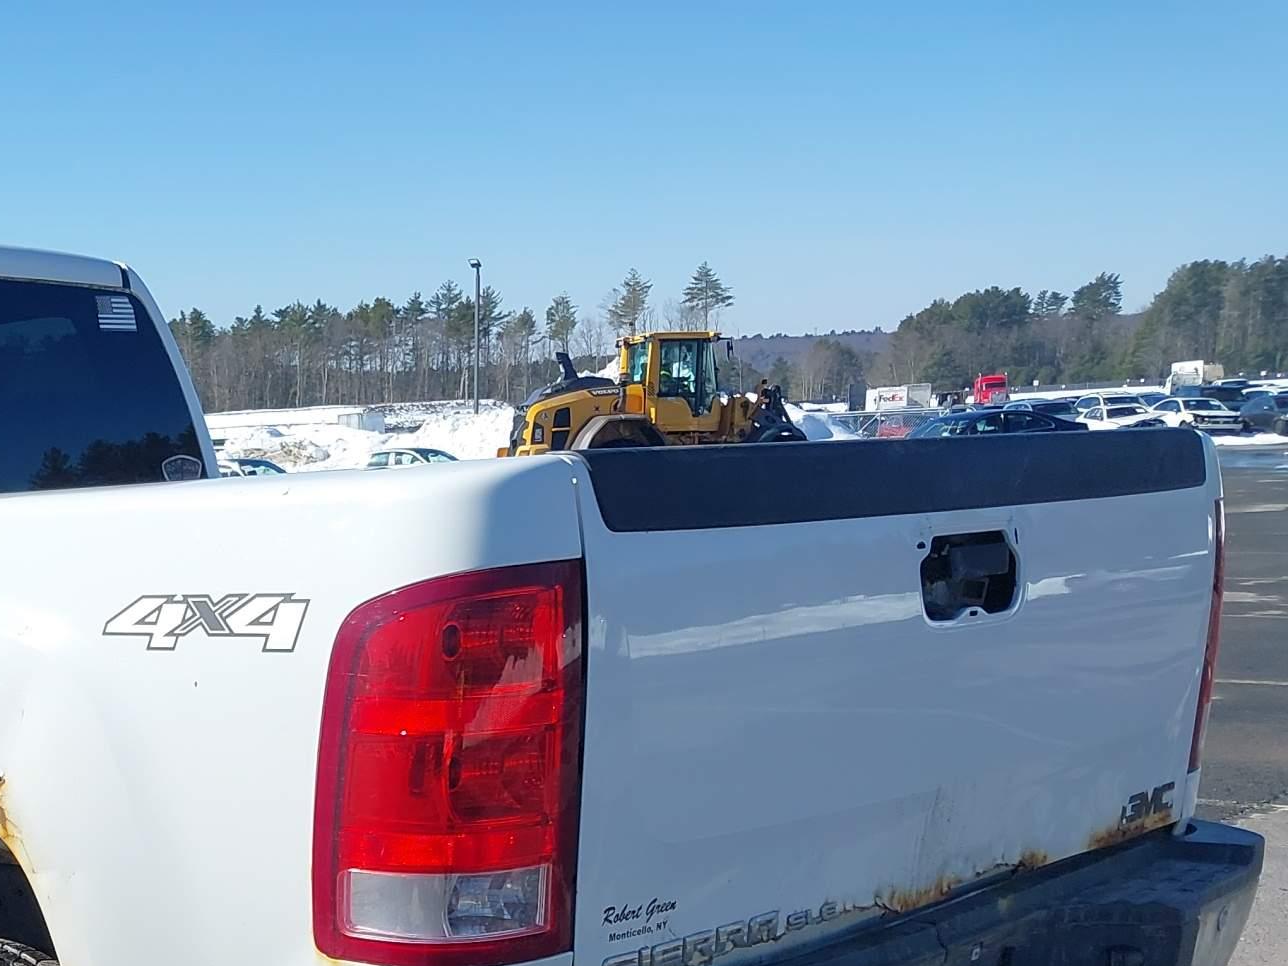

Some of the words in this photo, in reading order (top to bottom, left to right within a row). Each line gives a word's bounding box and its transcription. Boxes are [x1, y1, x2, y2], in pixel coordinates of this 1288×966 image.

[591, 388, 620, 396] VOLVO
[879, 394, 905, 402] FedEx
[602, 904, 644, 926] Robert
[646, 898, 676, 923] Green
[608, 926, 653, 942] Monticello,
[656, 920, 668, 931] NY
